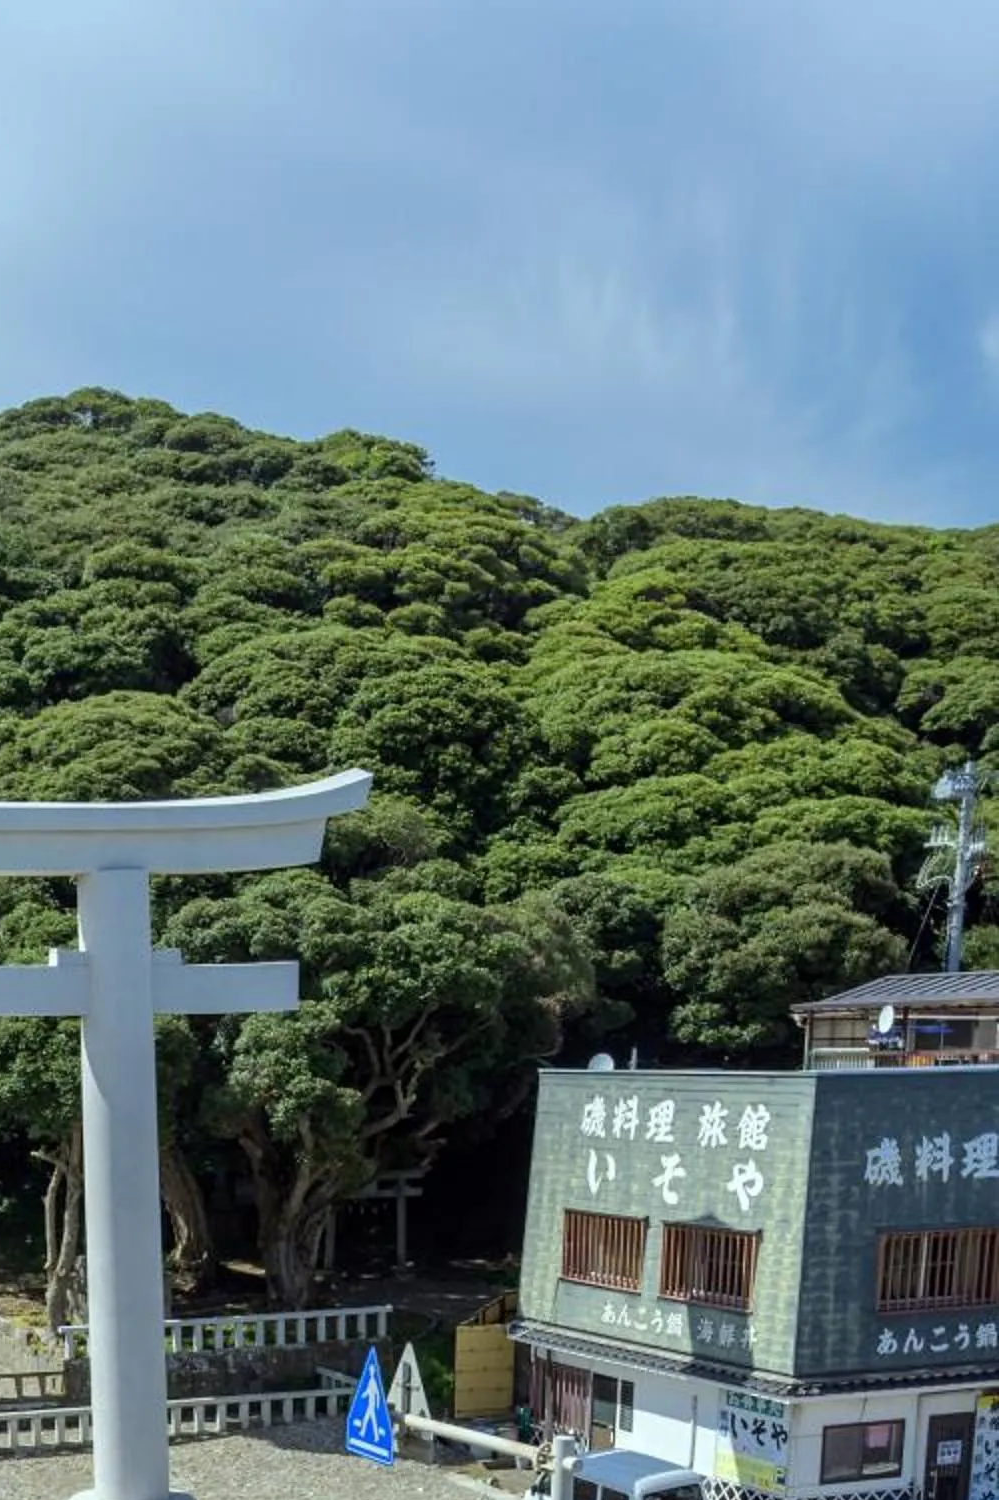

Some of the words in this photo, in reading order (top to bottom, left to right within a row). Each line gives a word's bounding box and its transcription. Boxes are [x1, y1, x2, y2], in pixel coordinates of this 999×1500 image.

[581, 1094, 675, 1142] 磯料理
[698, 1100, 771, 1150] 旅館
[587, 1148, 764, 1211] いそや
[864, 1130, 999, 1187] 磯料理
[601, 1301, 682, 1337] あんこう鍋
[877, 1323, 998, 1355] あんこう鍋
[730, 1413, 788, 1451] いそや
